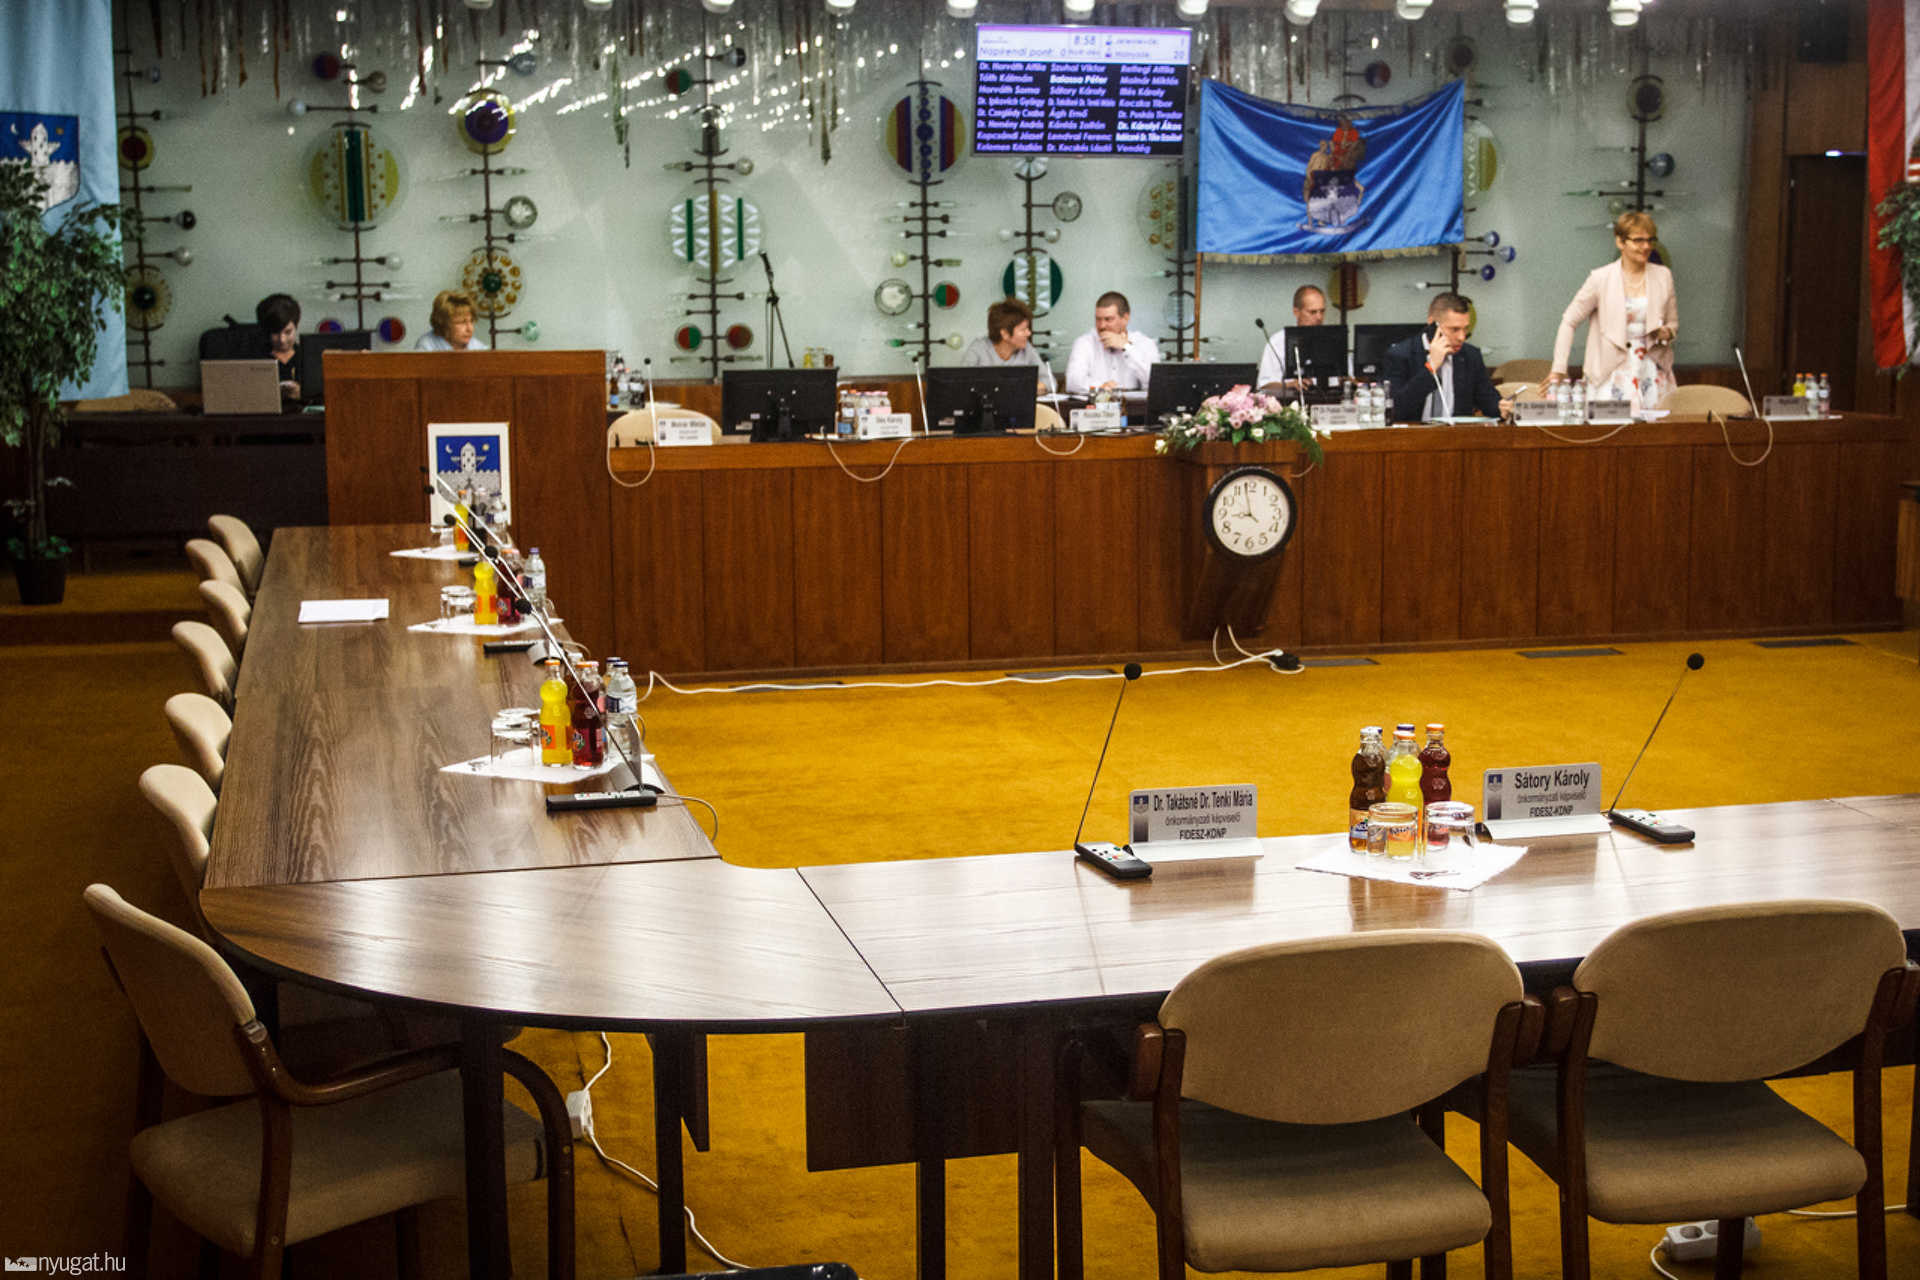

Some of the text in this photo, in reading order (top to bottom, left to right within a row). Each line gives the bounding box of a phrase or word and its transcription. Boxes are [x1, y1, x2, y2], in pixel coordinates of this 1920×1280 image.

[1074, 36, 1096, 45] 8:58
[979, 74, 997, 82] Tóth
[1085, 76, 1108, 84] Péter
[1079, 87, 1106, 96] Károly
[1137, 88, 1166, 98] Károly
[1234, 485, 1241, 496] 11
[1263, 486, 1266, 496] 1
[1223, 496, 1234, 506] 10
[1270, 495, 1278, 506] 2
[1218, 508, 1227, 520] 9
[1272, 508, 1281, 520] 3
[1221, 521, 1231, 533] 8
[1268, 521, 1278, 533] 4
[1233, 532, 1242, 544] 7
[1245, 536, 1254, 549] 6
[1258, 532, 1268, 545] 5
[1514, 770, 1590, 792] Sátory Károly
[1154, 790, 1253, 812] Dr. Takátsné Dr. Tenki Mária
[1529, 805, 1573, 817] FIDESZ-KDNP
[1179, 827, 1227, 840] FIDESZ-KDNP
